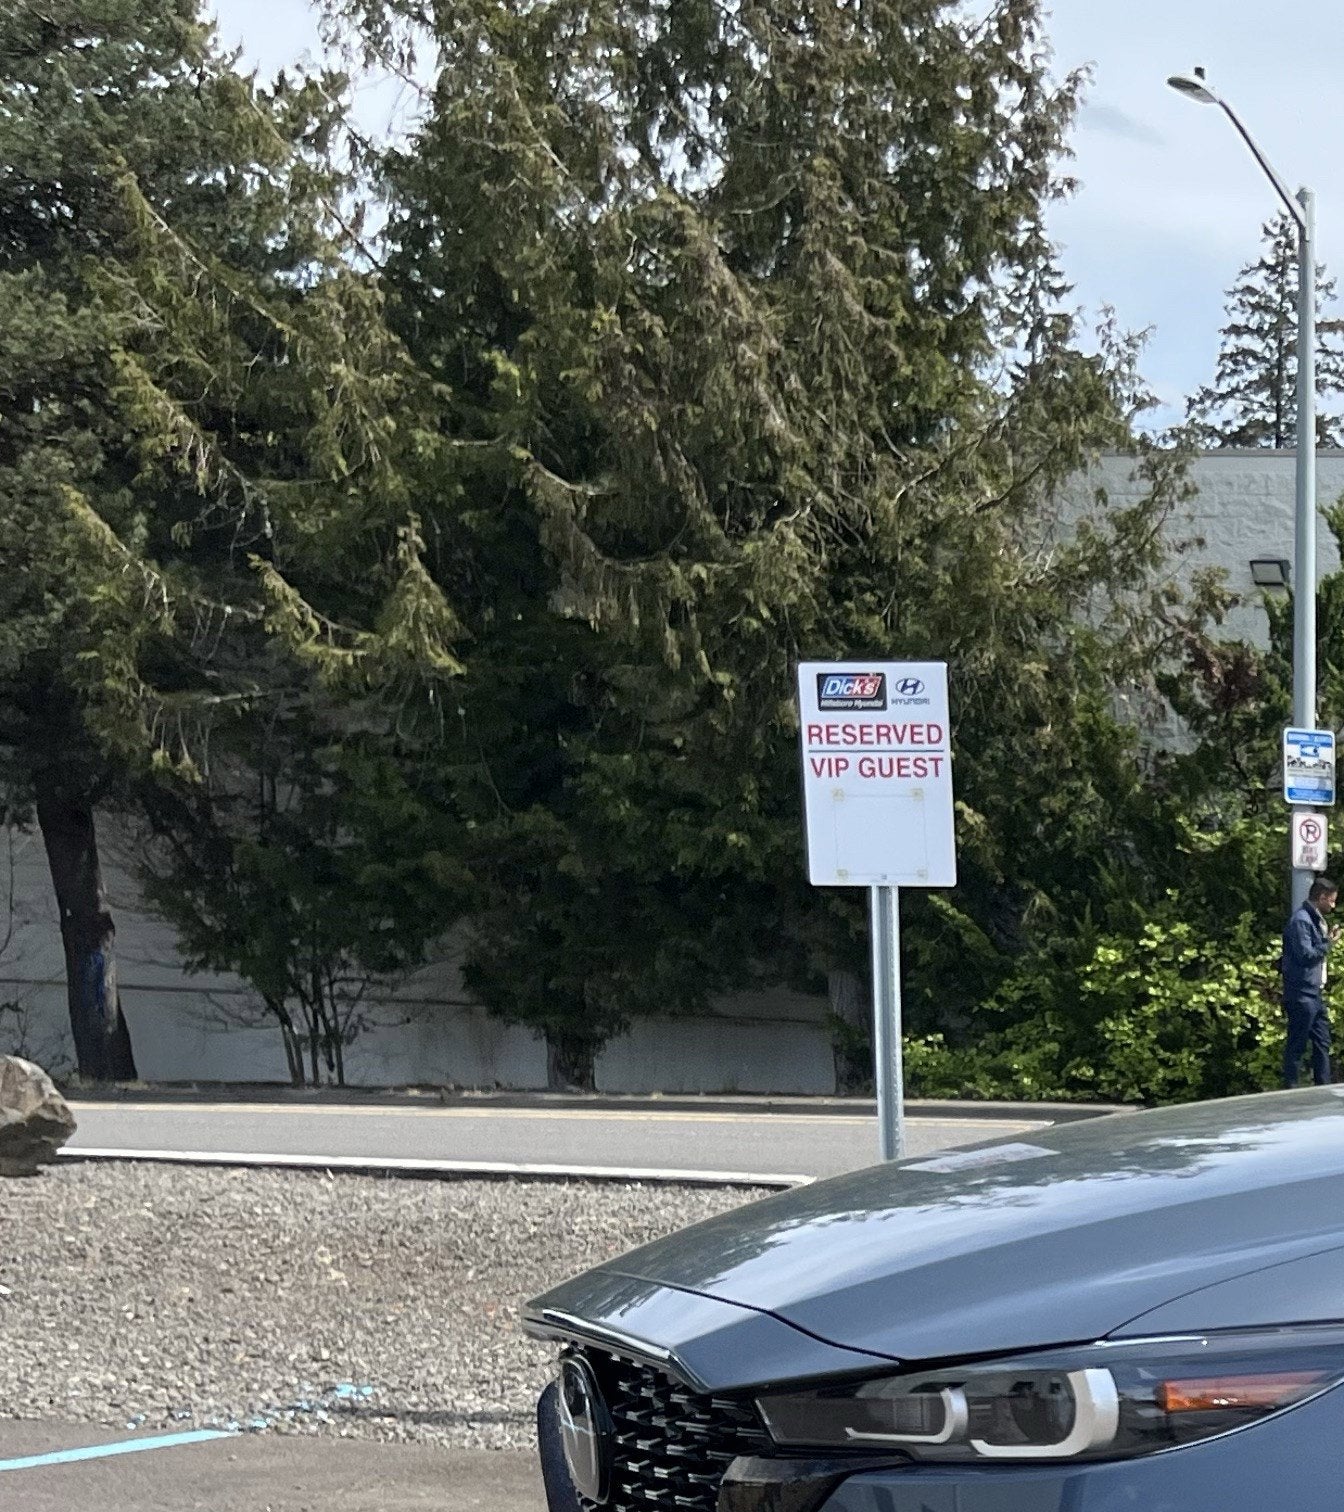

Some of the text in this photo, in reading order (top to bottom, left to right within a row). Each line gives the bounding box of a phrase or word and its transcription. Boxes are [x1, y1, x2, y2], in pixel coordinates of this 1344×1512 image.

[825, 678, 875, 696] Dick's
[807, 724, 943, 746] RESERVED
[810, 757, 944, 779] VIP GUEST
